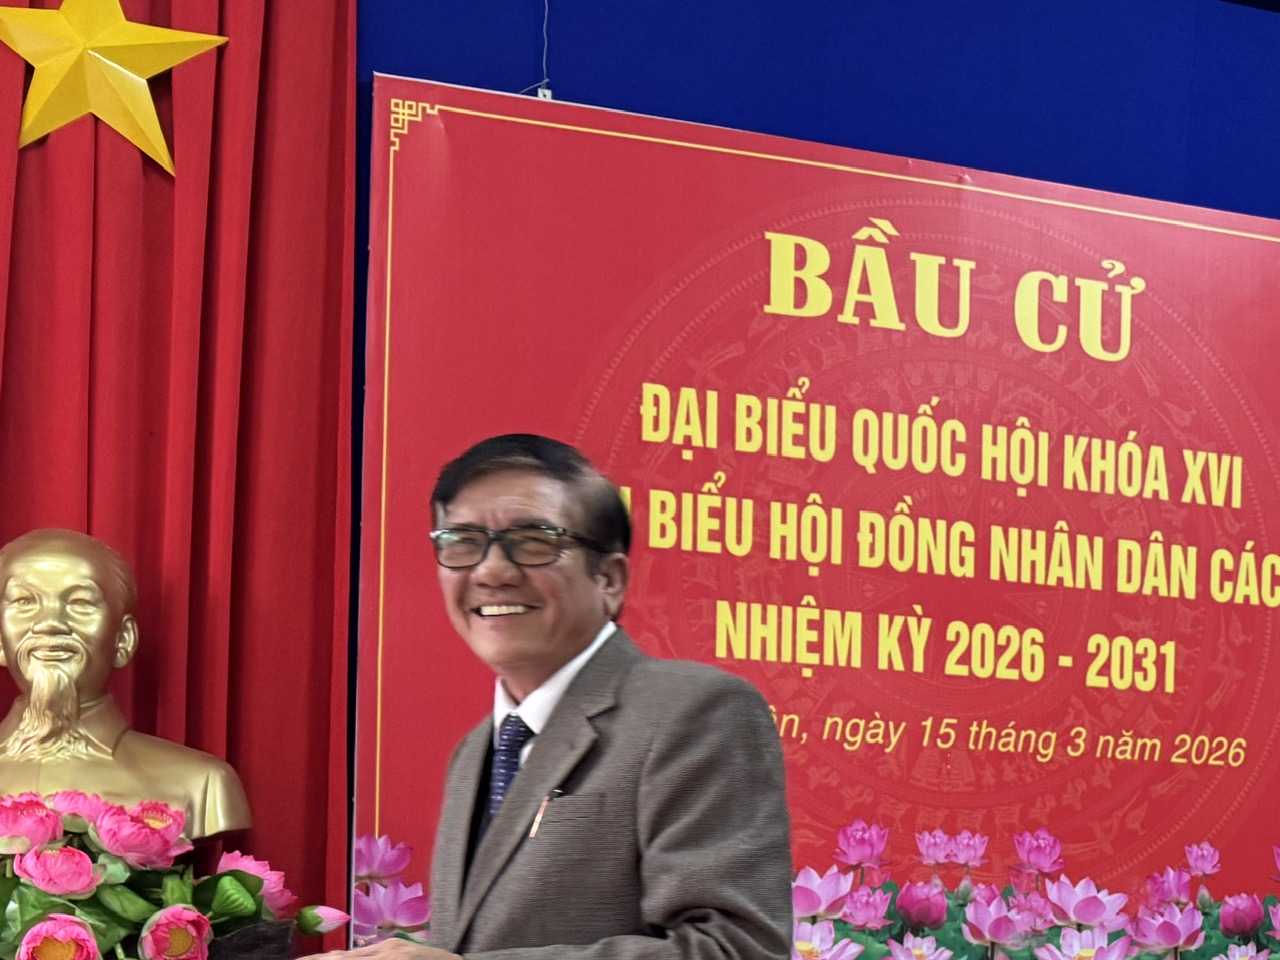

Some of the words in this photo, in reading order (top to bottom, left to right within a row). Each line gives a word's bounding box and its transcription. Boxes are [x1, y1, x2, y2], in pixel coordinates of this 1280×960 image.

[763, 217, 977, 338] BẦU
[1013, 258, 1147, 362] CỬ
[639, 382, 718, 461] ĐẠI
[735, 376, 837, 463] BIỂU
[852, 395, 967, 477] QUỐC
[981, 416, 1049, 498] HỘI
[1063, 430, 1170, 501] KHÓA
[1180, 449, 1243, 509] XVI
[648, 470, 754, 557] BIỂU
[769, 492, 843, 577] HỘI
[856, 495, 975, 578] ĐỒNG
[989, 520, 1104, 591] NHÂN
[1116, 530, 1198, 600] DÂN
[715, 594, 863, 678] NHIỆM
[877, 604, 932, 673] KỲ
[944, 620, 1045, 683] 2026
[1058, 655, 1073, 667] -
[1085, 633, 1176, 694] 2031
[822, 711, 906, 753] ngày
[921, 716, 958, 749] 15
[968, 719, 1057, 763] tháng
[1066, 726, 1087, 757] 3
[1096, 729, 1161, 761] năm
[1170, 734, 1247, 767] 2026
